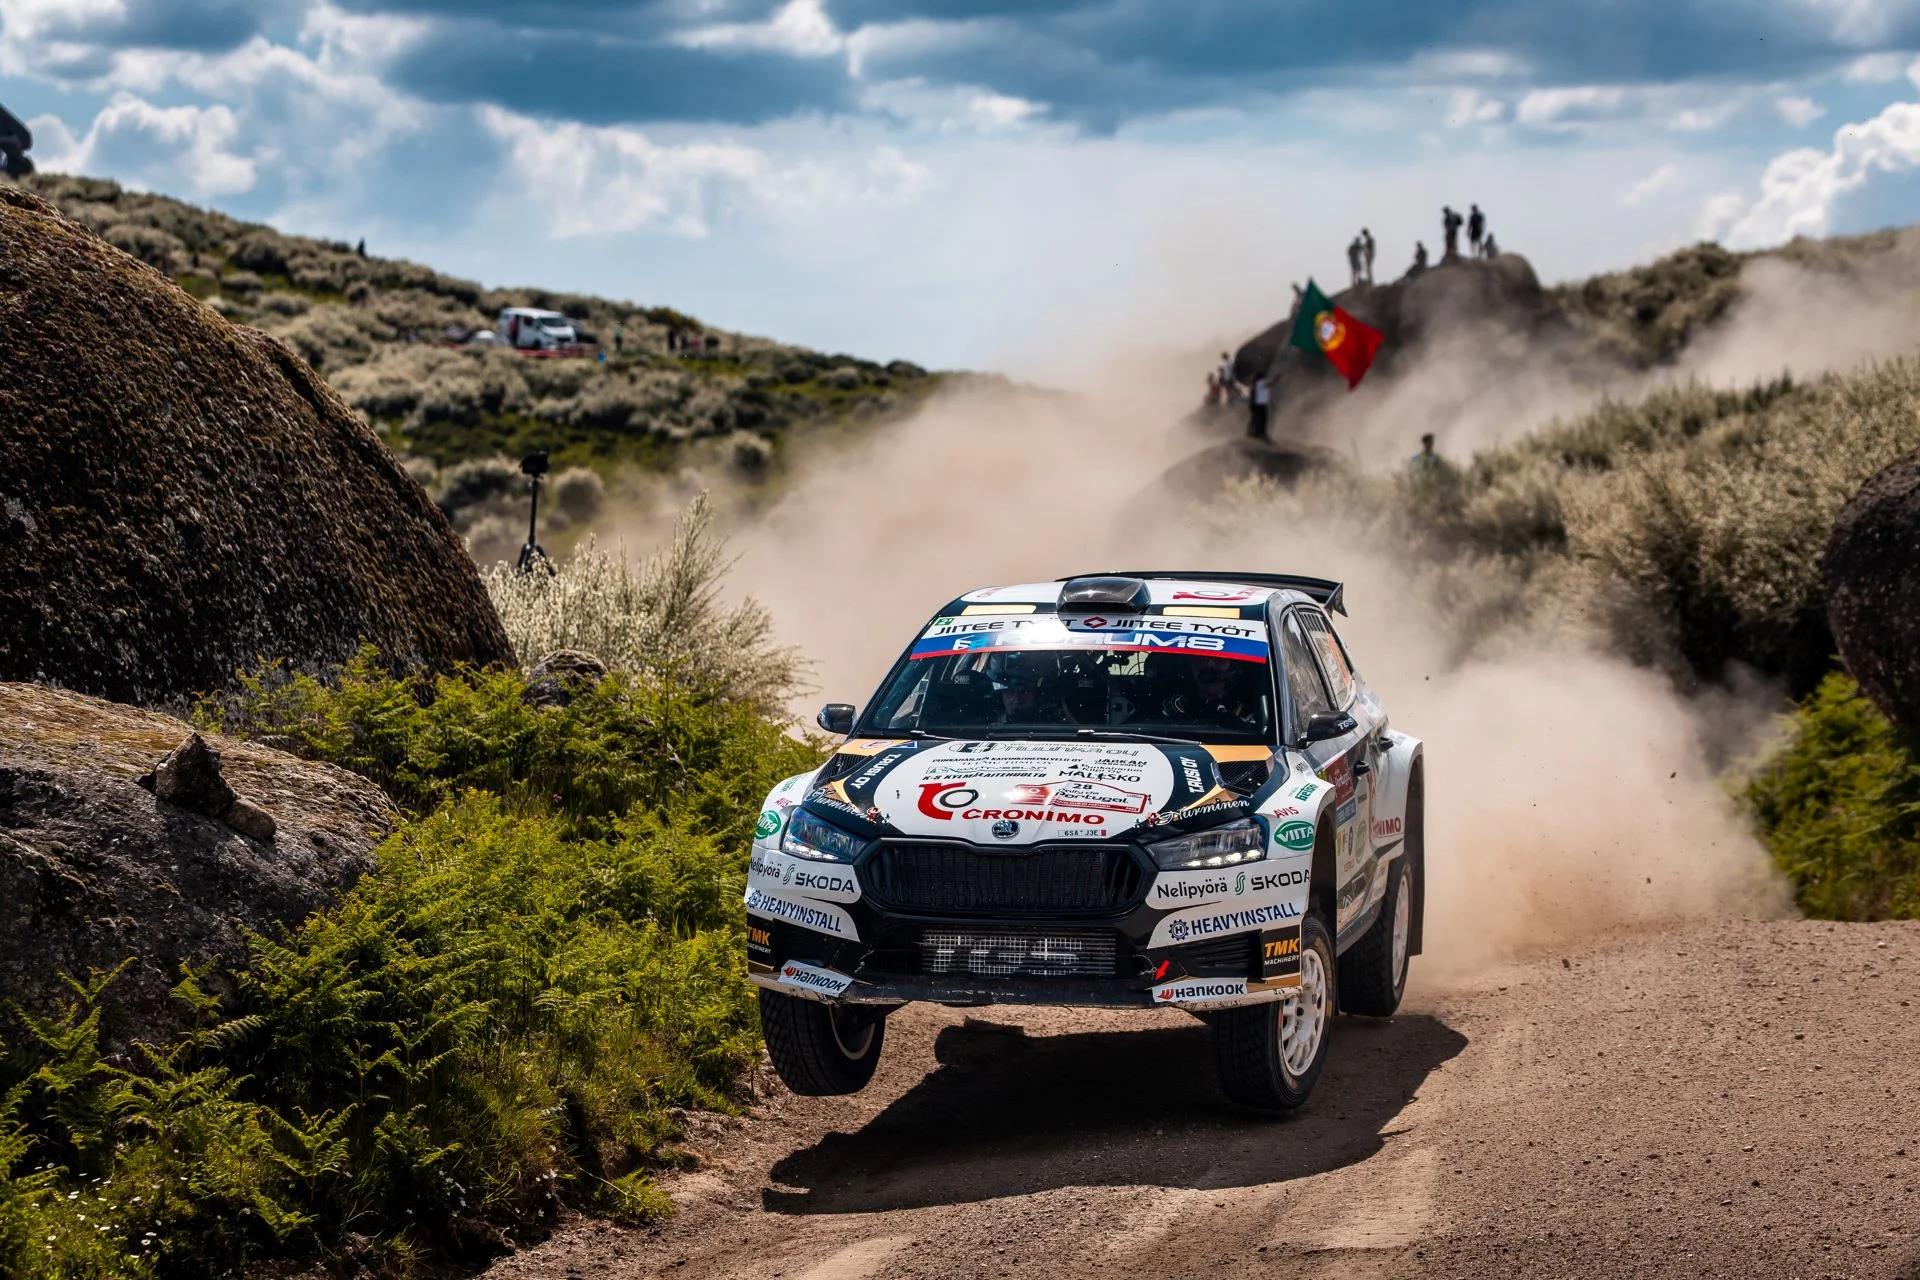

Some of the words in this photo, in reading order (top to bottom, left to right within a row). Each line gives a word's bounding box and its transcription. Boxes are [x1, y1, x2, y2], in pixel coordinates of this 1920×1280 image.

[935, 621, 1004, 636] JIITEE
[1110, 618, 1182, 631] JIITEE
[1190, 622, 1256, 638] TYÖT
[1179, 756, 1199, 768] OY
[1054, 791, 1129, 804] Portugal
[962, 808, 1105, 825] CRONIMO
[1273, 806, 1300, 818] AVIS
[1157, 877, 1228, 900] Nelipyörä
[761, 894, 842, 933] HEAVYINSTALL
[1190, 902, 1301, 936] HEAVYINSTALL
[748, 926, 771, 946] TMK
[1264, 937, 1301, 958] TMK
[1263, 955, 1301, 967] MACHINERY
